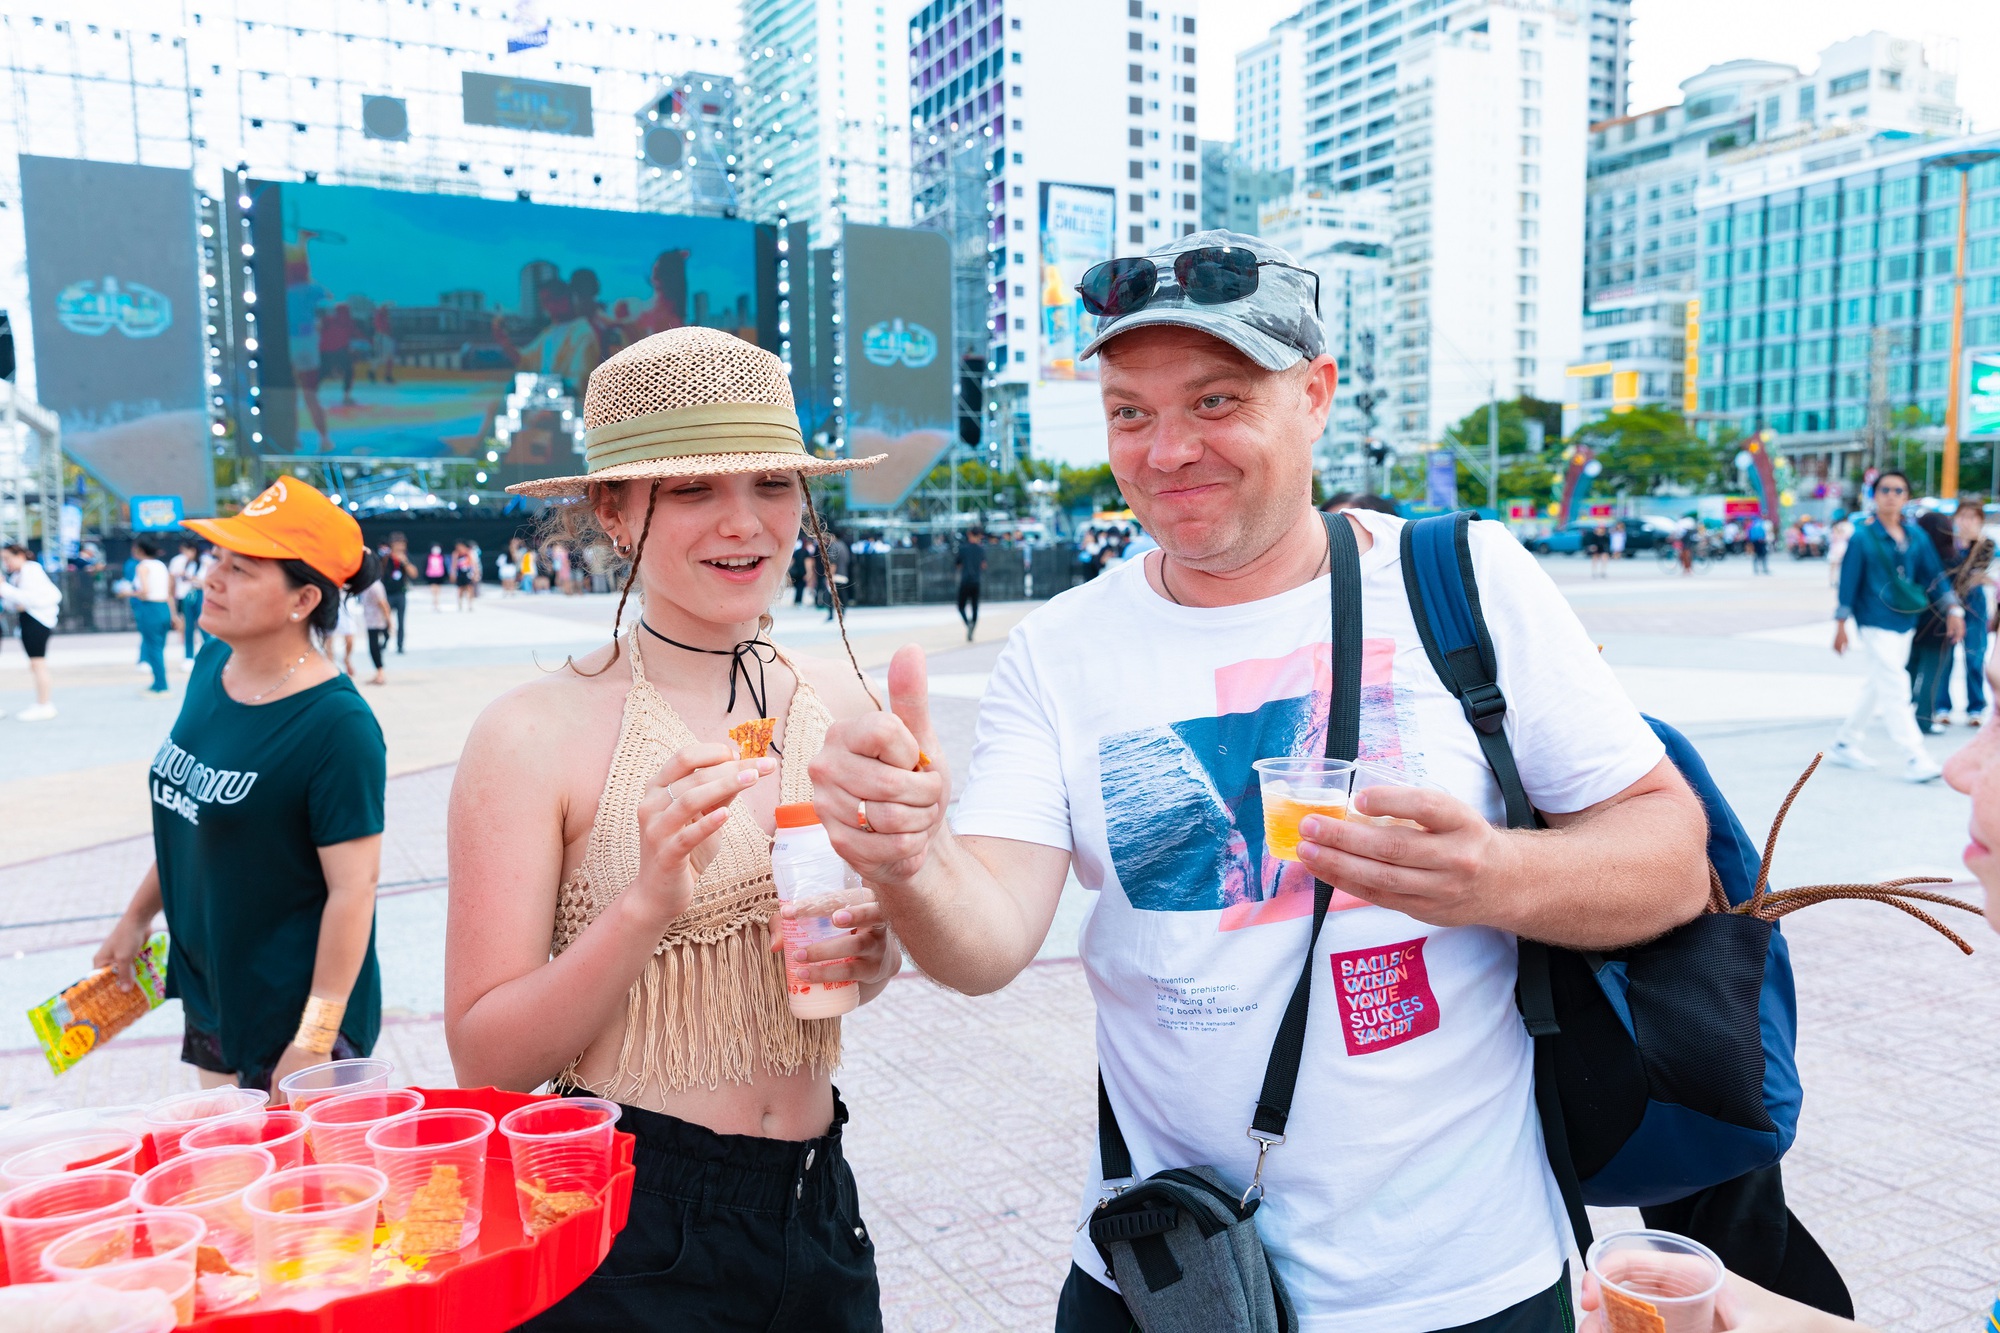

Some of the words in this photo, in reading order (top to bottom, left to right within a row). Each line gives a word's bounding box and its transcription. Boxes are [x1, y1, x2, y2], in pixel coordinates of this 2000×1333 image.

[1177, 1007, 1202, 1015] boats
[1205, 1007, 1213, 1015] is
[1216, 1002, 1259, 1015] believed
